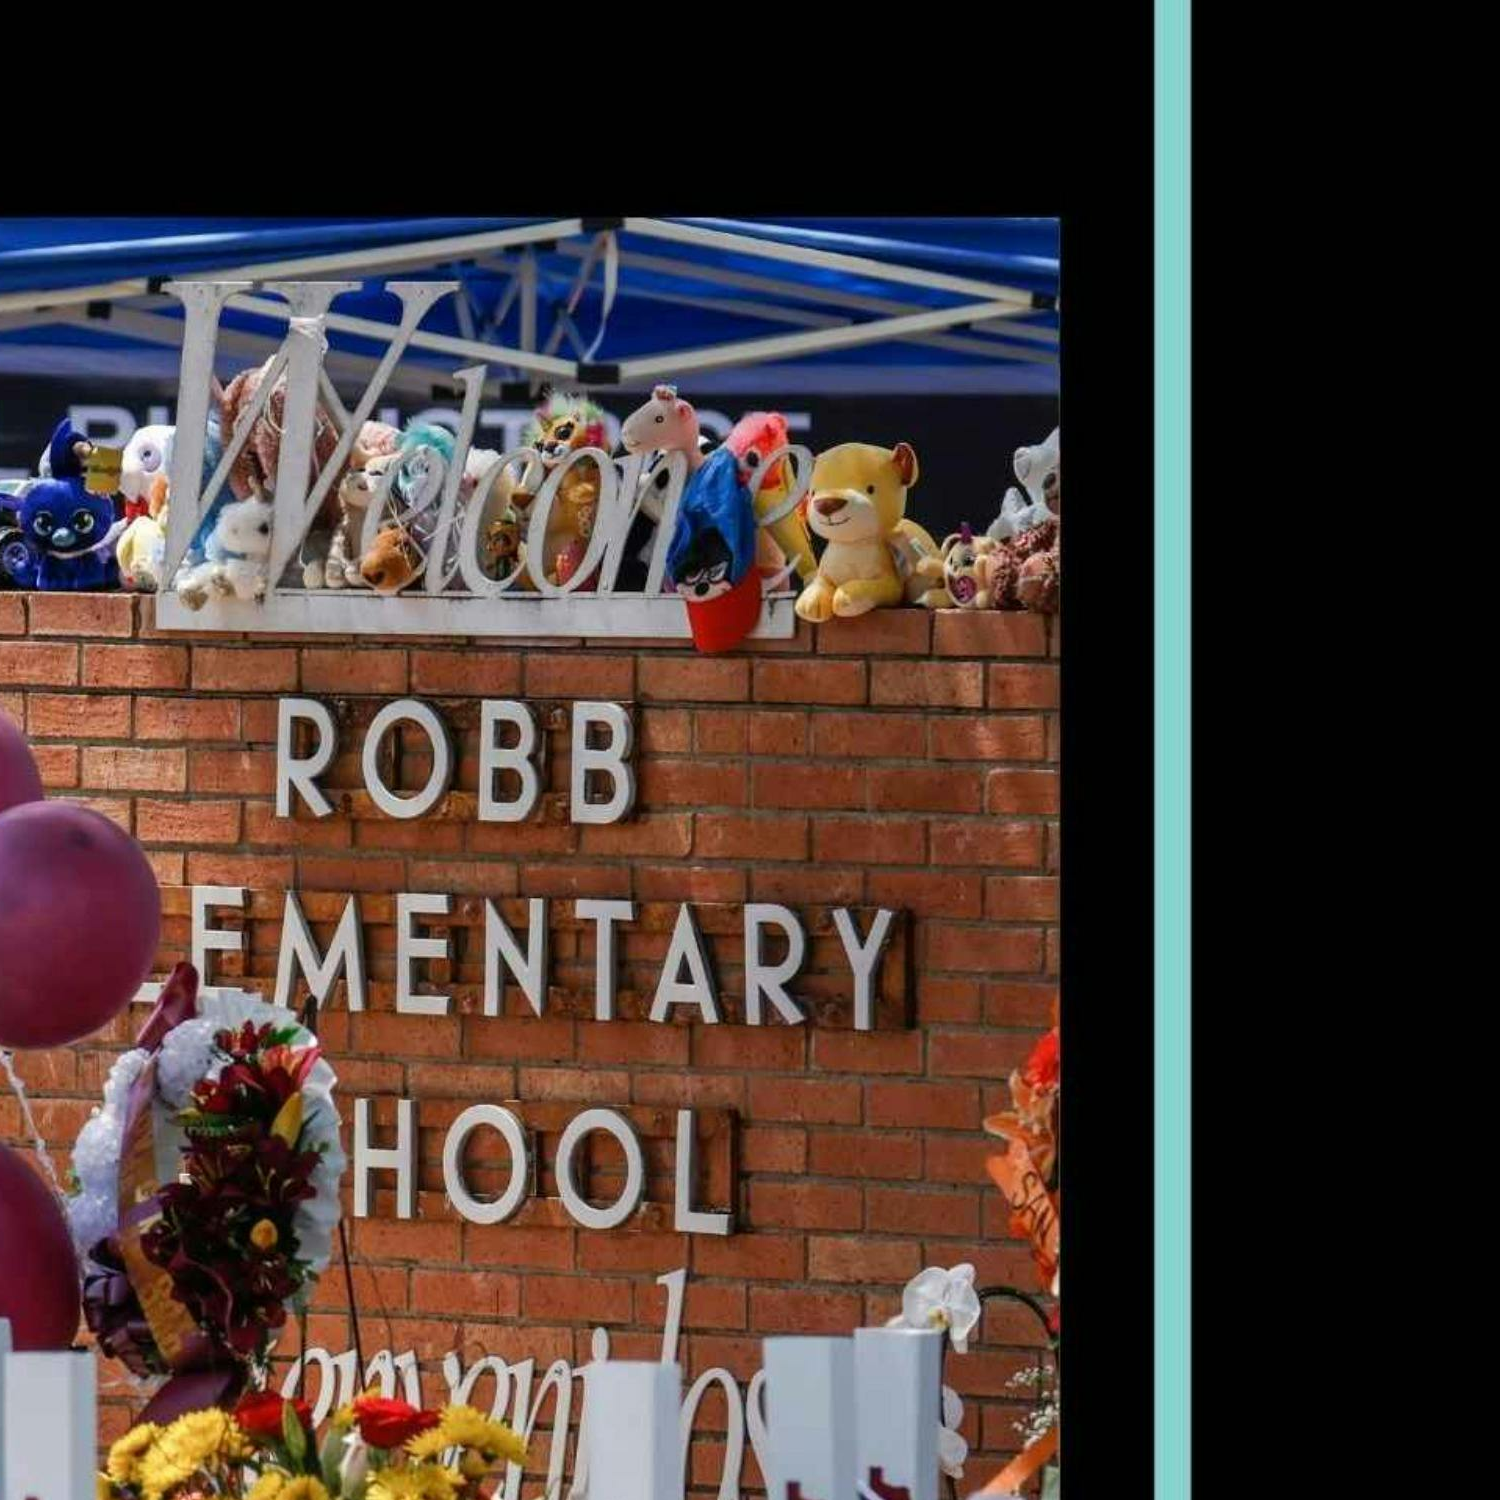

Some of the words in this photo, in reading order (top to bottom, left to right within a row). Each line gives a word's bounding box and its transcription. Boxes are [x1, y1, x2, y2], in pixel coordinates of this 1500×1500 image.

[275, 698, 638, 825] ROBB
[133, 885, 896, 1031] EMENTARY
[353, 1098, 730, 1236] HOOL
